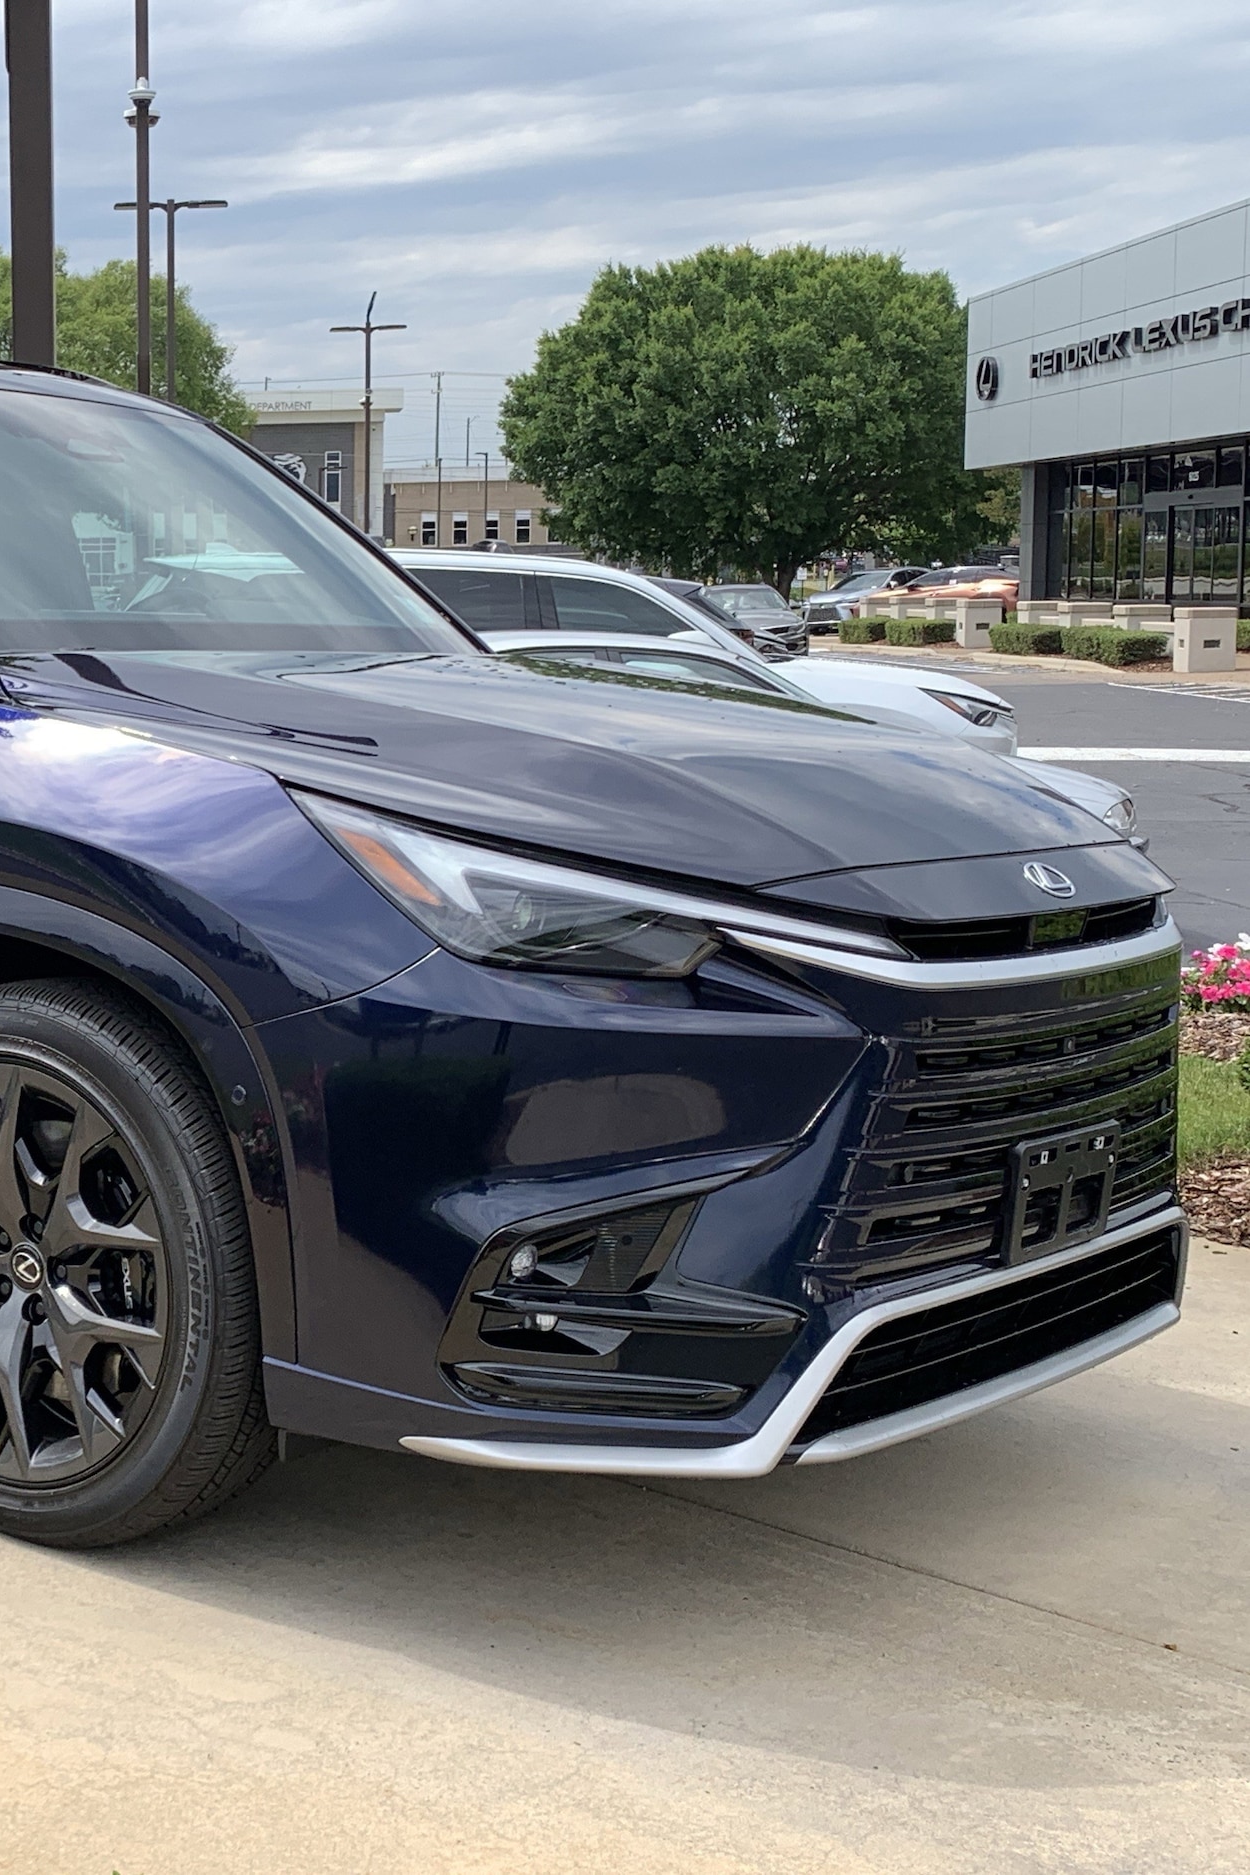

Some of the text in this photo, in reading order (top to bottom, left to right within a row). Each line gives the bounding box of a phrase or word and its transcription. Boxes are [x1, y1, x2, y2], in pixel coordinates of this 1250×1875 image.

[1029, 331, 1129, 379] HENDRICK
[1130, 306, 1218, 354] LEXUS
[249, 401, 312, 412] DEPARTMENT
[166, 1168, 203, 1393] CONTINENTAL
